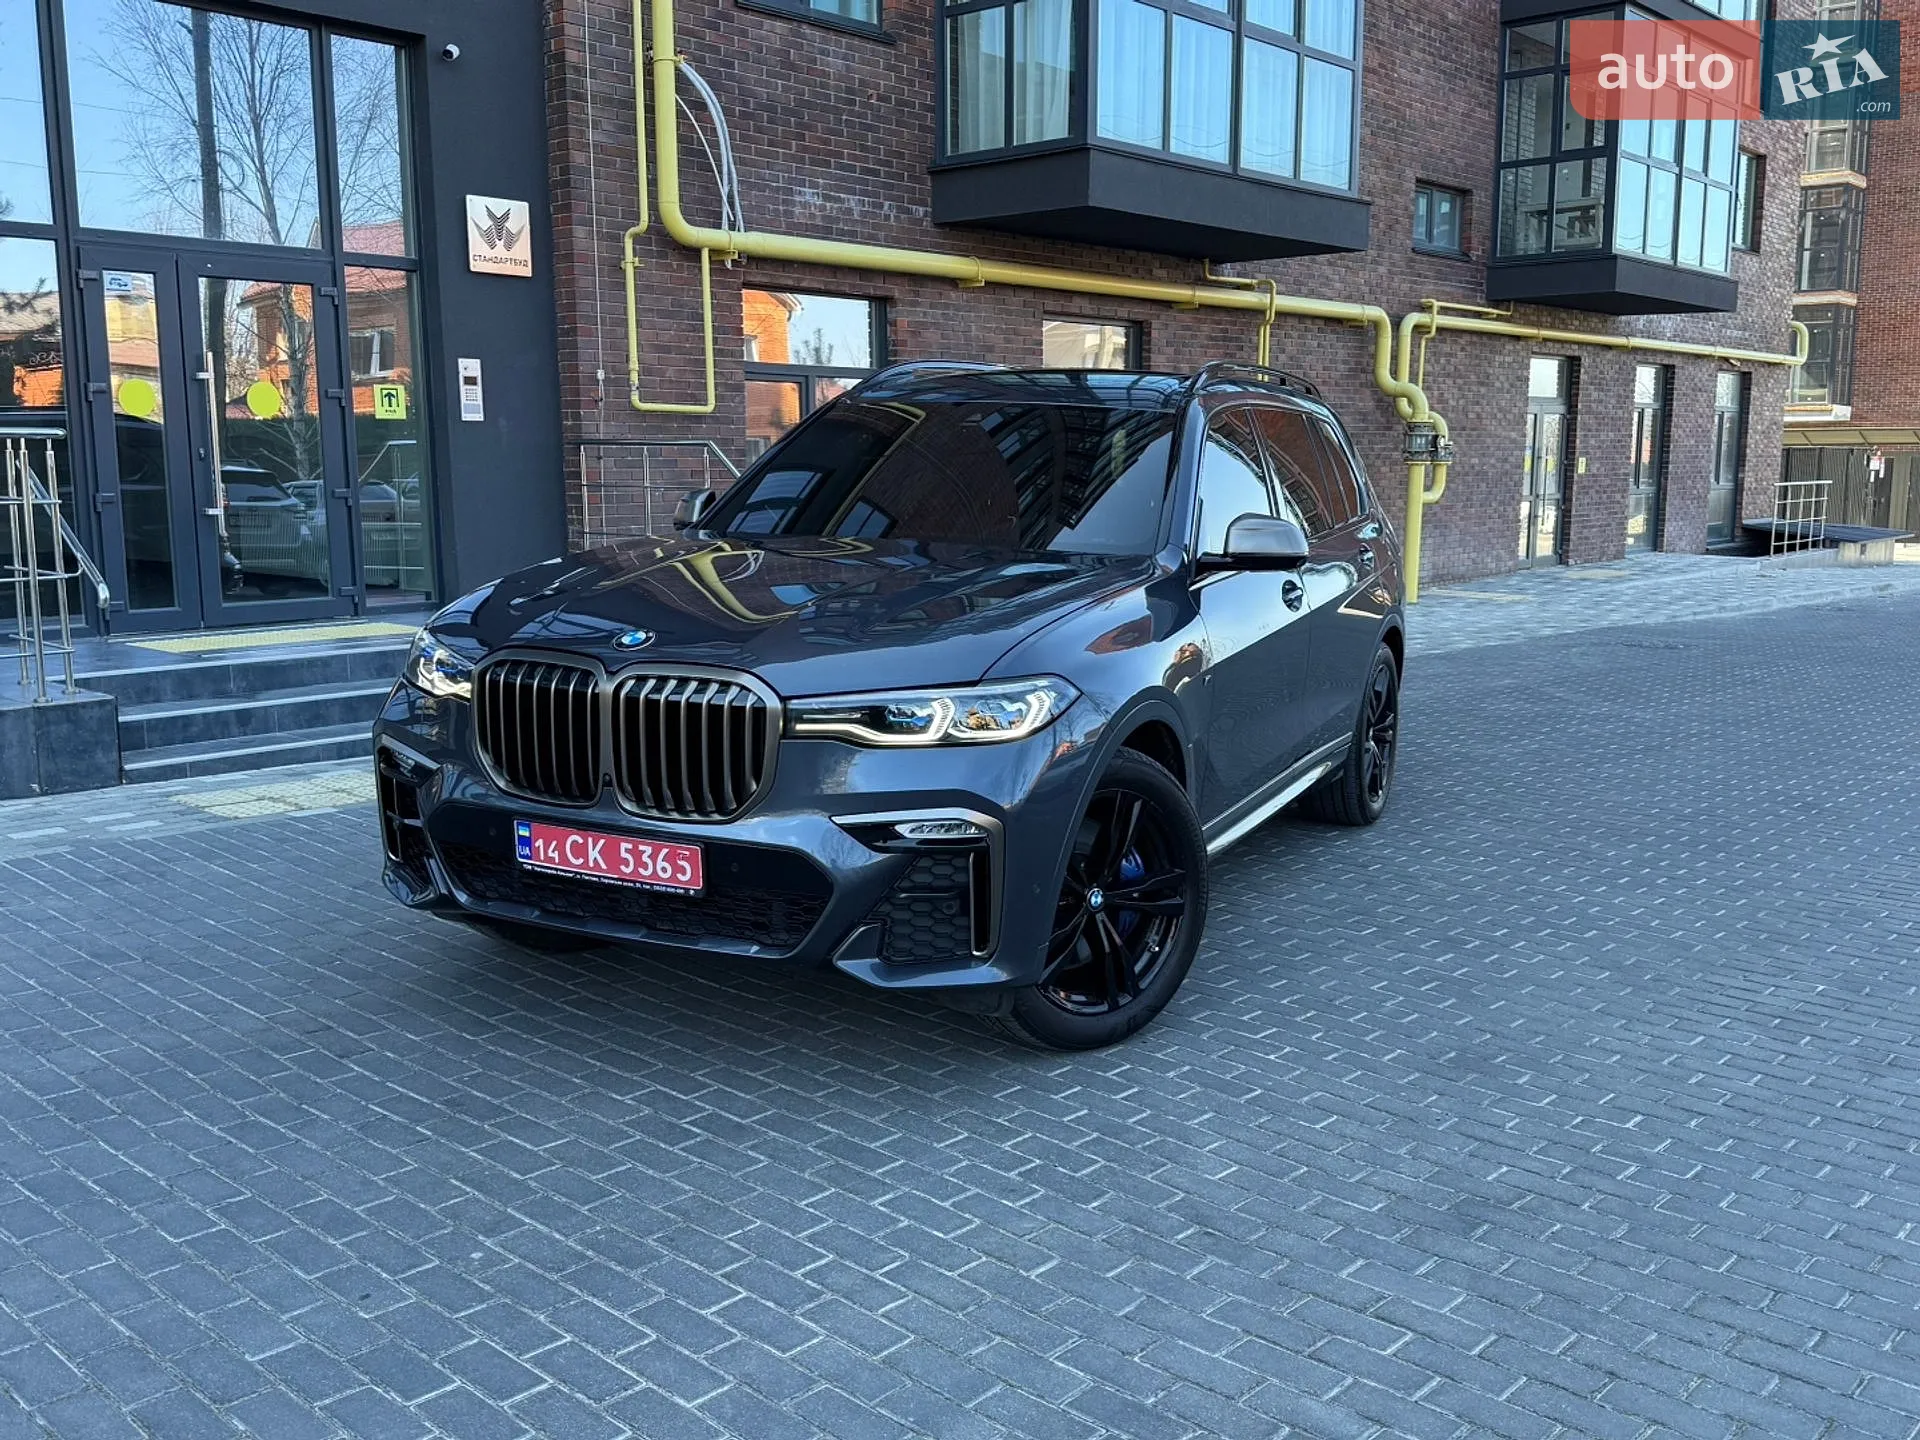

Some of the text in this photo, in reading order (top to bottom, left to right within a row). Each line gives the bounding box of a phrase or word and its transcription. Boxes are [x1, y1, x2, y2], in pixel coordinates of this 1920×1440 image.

[472, 254, 529, 268] СТАНДАРТБУД
[518, 845, 531, 857] UA
[534, 838, 559, 863] 14
[619, 842, 692, 882] 5365
